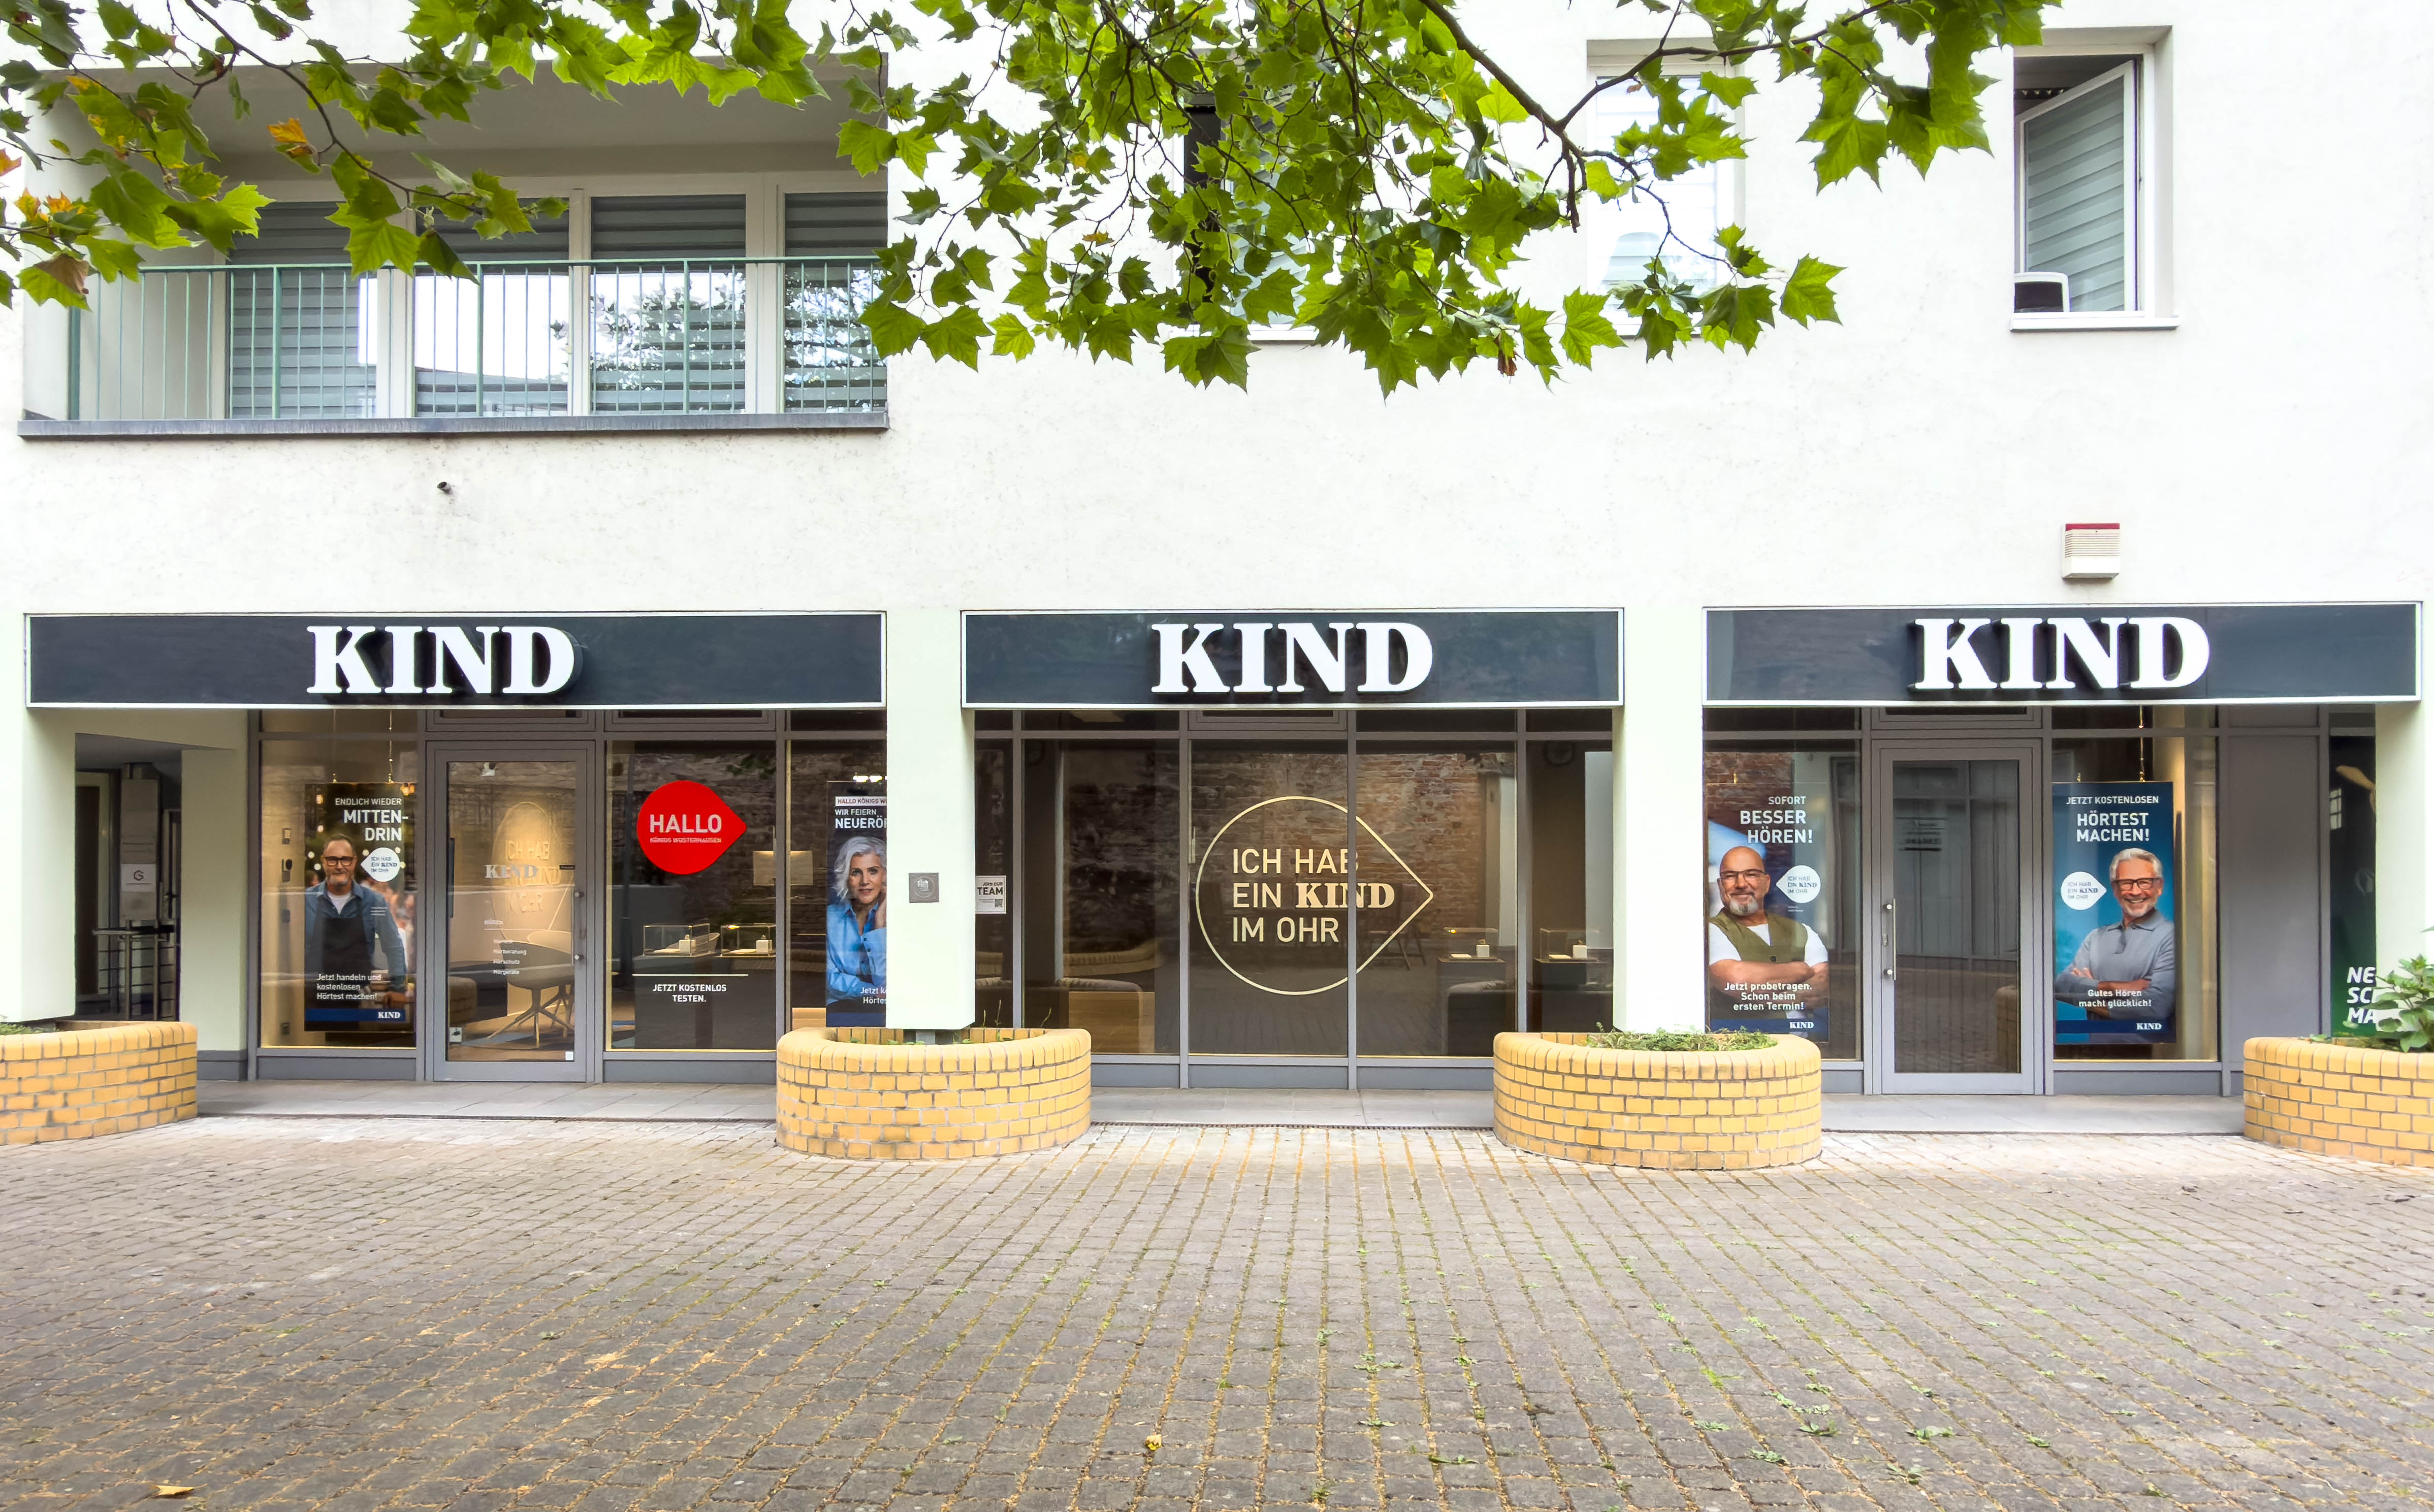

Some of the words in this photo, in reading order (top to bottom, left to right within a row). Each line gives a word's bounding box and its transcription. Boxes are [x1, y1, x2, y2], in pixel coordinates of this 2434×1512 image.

[306, 626, 574, 693] KIND
[1151, 623, 1433, 692] KIND
[1914, 617, 2210, 689] KIND
[1768, 796, 1807, 805] SOFORT
[2066, 796, 2093, 805] JETZT
[2095, 796, 2159, 804] KOSTENLOSEN
[343, 810, 409, 823] MITTEN-
[650, 814, 722, 833] HALLO
[1740, 810, 1807, 824] BESSER
[2077, 810, 2149, 826] HÖRTEST
[365, 827, 402, 841] DRIN
[1748, 826, 1813, 844] HÖREN!
[2076, 828, 2150, 842] MACHEN!
[1233, 849, 1281, 874] ICH
[1295, 849, 1358, 874] HAB
[485, 864, 538, 879] KIND
[977, 887, 1004, 895] TEAM
[1233, 883, 1281, 908] EIN
[1295, 883, 1395, 908] KIND
[1233, 917, 1264, 942] IM
[1276, 917, 1339, 942] OHR
[1724, 983, 1748, 991] Jetzt
[1750, 982, 1812, 992] probetragen.
[1741, 992, 1770, 1000] Schon
[1766, 1002, 1804, 1010] Termin!
[2079, 999, 2106, 1007] macht
[2108, 999, 2152, 1009] glücklich!
